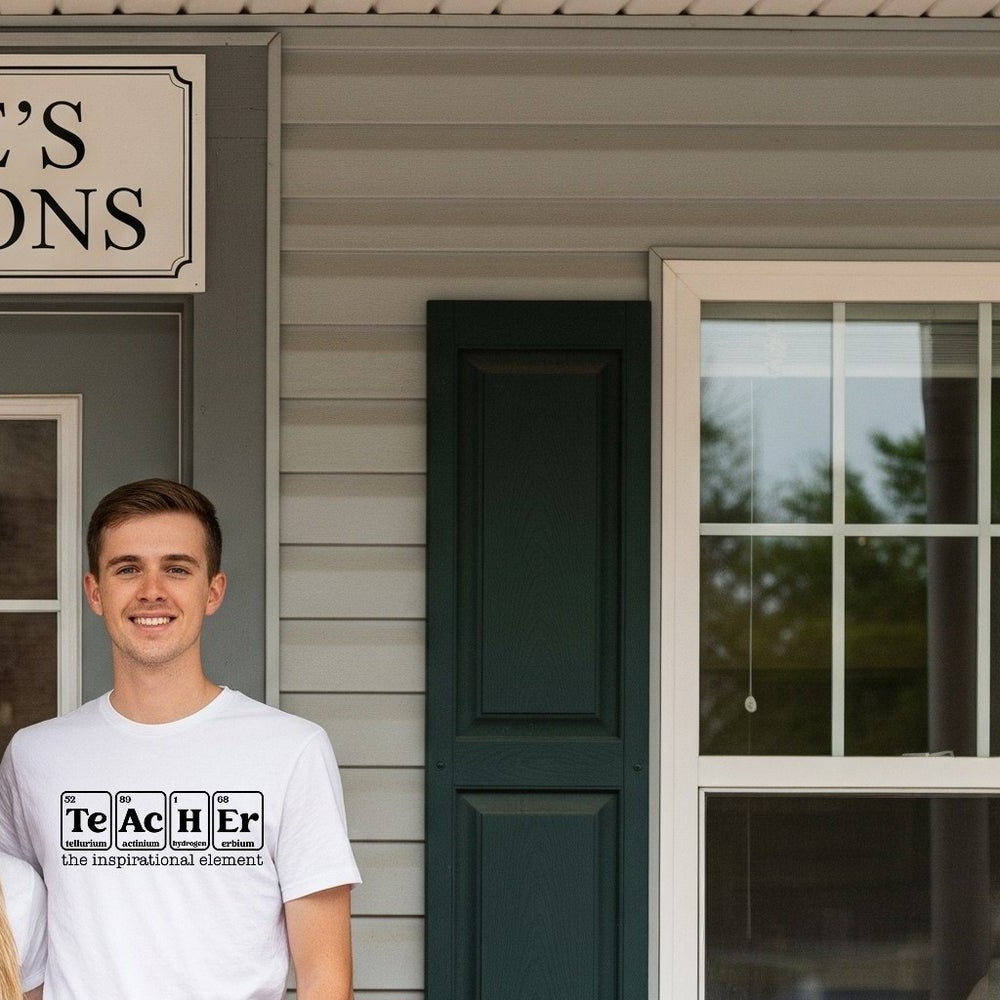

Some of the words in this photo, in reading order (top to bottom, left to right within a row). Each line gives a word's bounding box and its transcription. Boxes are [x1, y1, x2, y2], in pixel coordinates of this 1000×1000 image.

[64, 795, 76, 804] 52
[119, 795, 131, 804] 89
[173, 796, 178, 804] 1
[217, 795, 229, 804] 68
[65, 808, 107, 833] Te
[118, 808, 164, 833] Ac
[177, 809, 202, 833] H
[217, 809, 260, 833] Er
[65, 839, 107, 848] tellurium
[122, 839, 160, 848] actinium
[172, 840, 207, 848] hydrogen
[221, 839, 255, 848] erbium
[61, 853, 88, 866] the
[92, 853, 195, 869] inspirational
[199, 853, 264, 866] element
